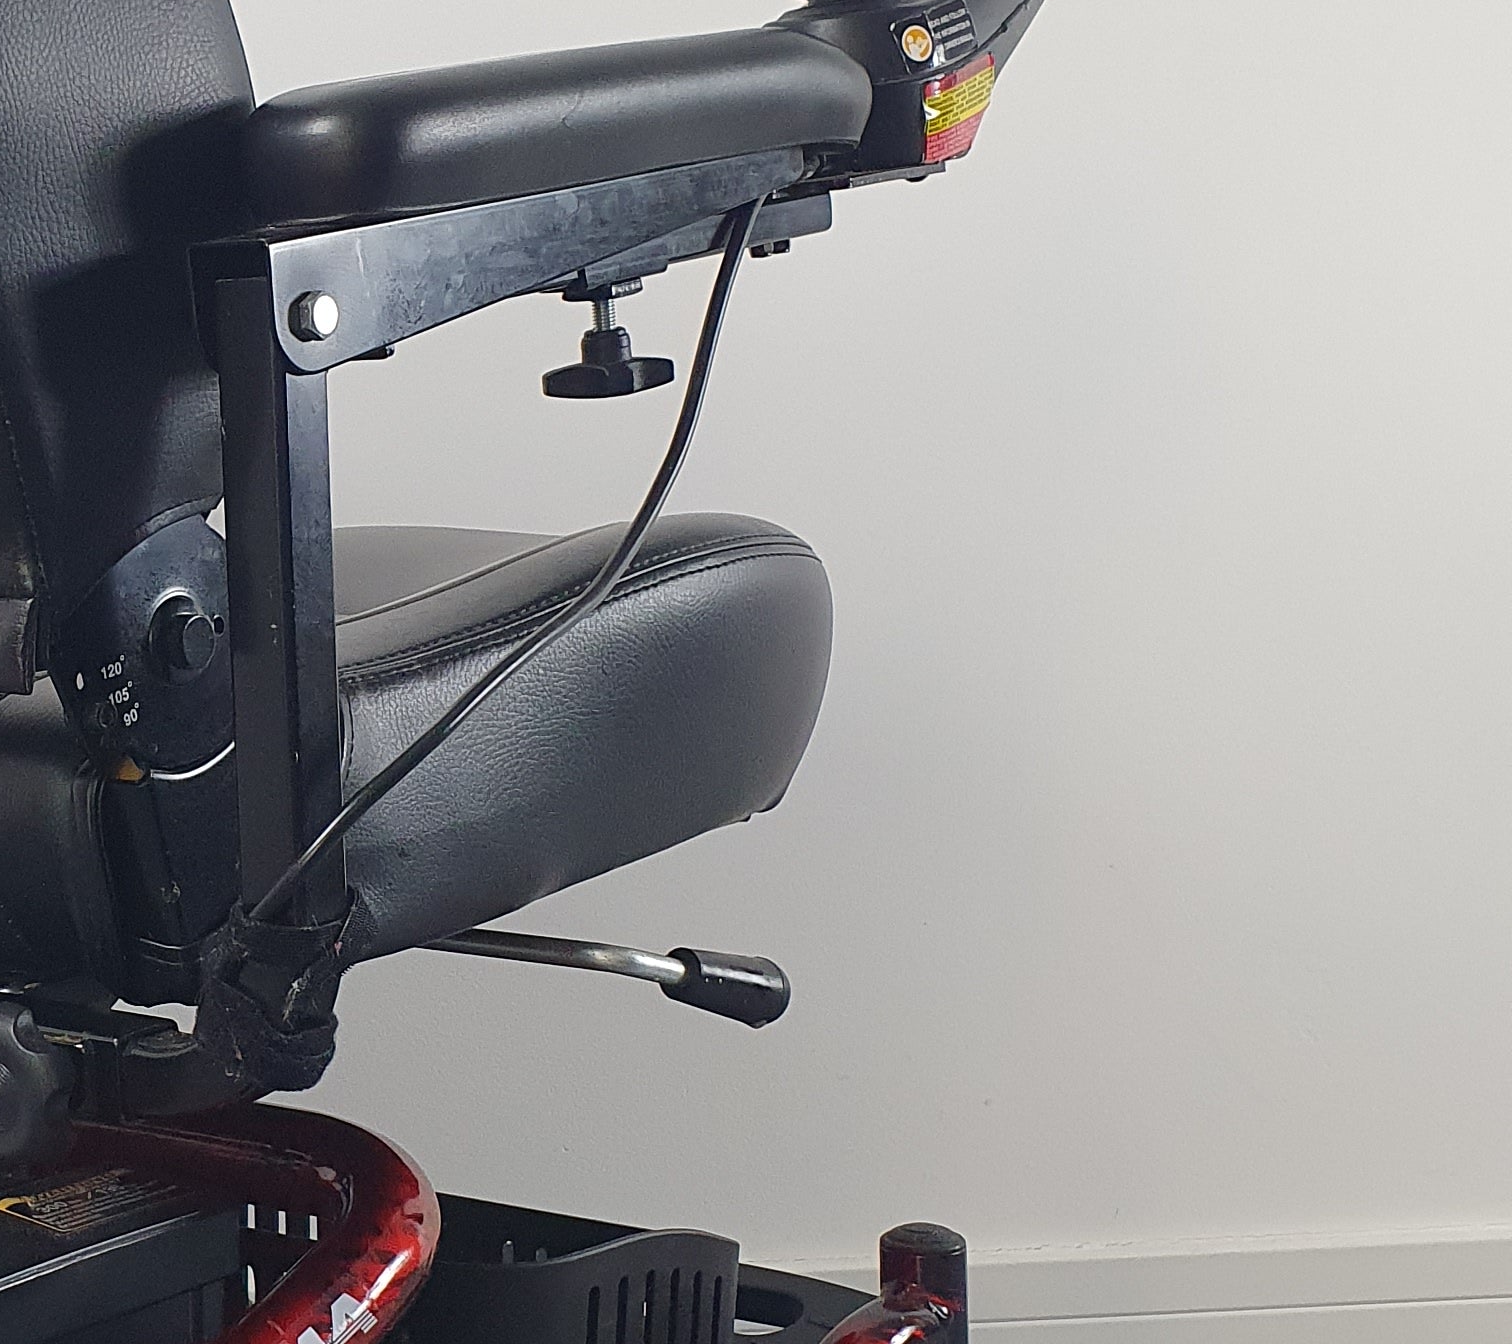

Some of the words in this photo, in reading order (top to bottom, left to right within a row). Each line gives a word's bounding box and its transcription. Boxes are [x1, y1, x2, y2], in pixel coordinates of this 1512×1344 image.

[101, 654, 125, 680] 120°
[108, 681, 133, 705] 105°
[123, 702, 140, 727] 90°
